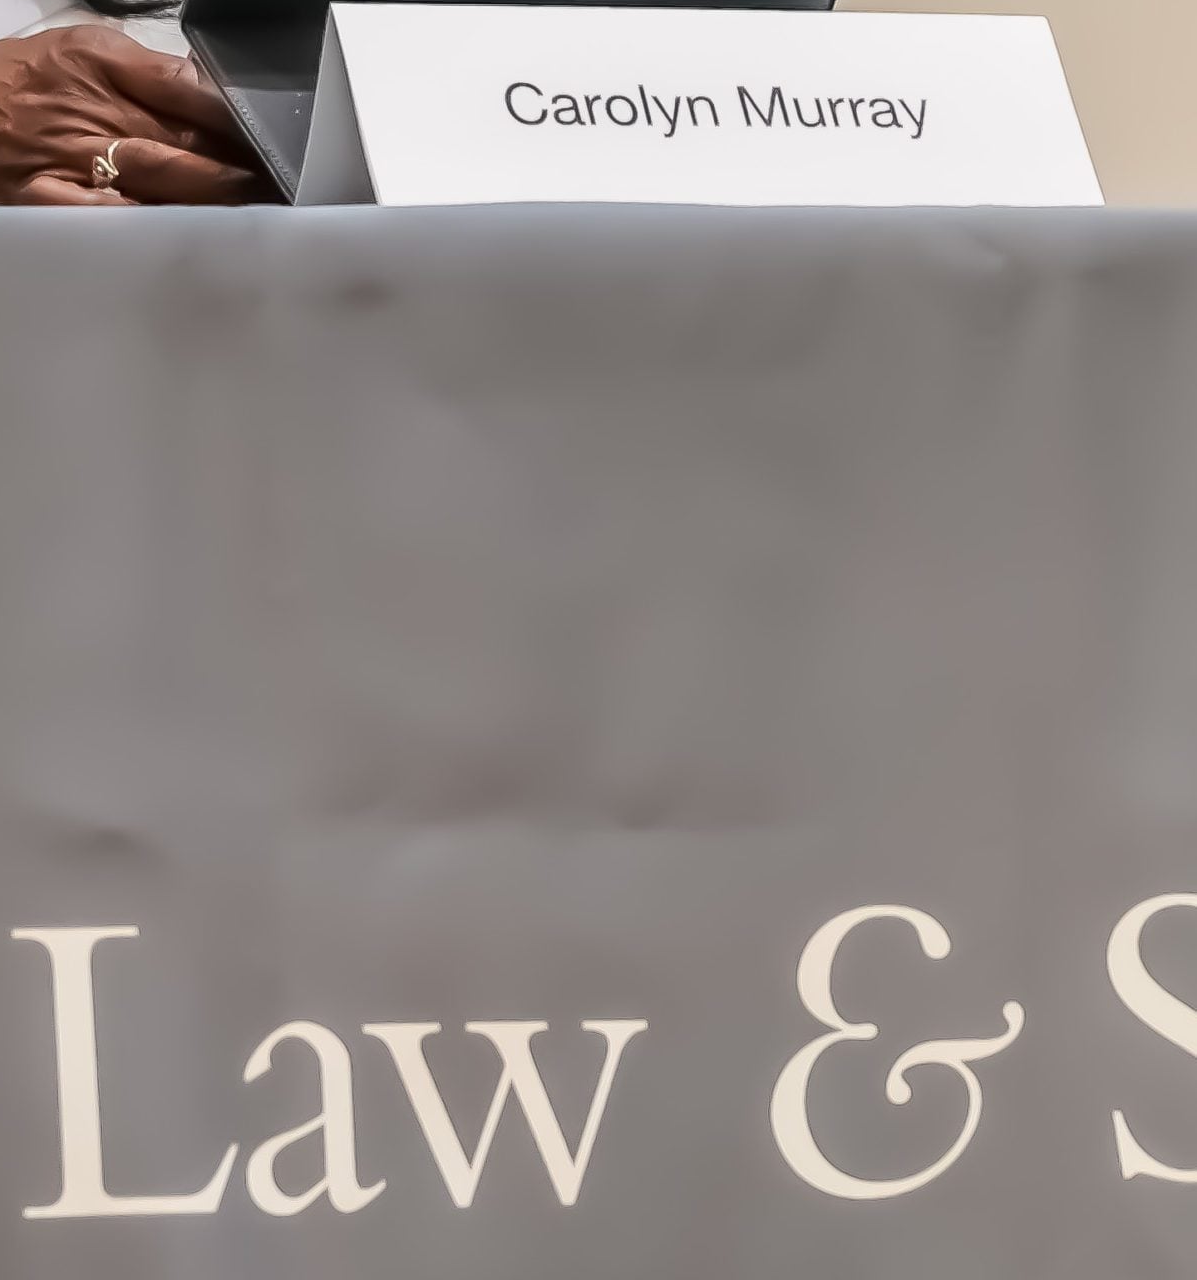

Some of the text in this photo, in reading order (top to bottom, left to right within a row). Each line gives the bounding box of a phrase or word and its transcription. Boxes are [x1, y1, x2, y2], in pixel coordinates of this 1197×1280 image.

[504, 82, 927, 140] Carolyn Murray
[11, 926, 648, 1218] Law
[770, 904, 1025, 1199] &
